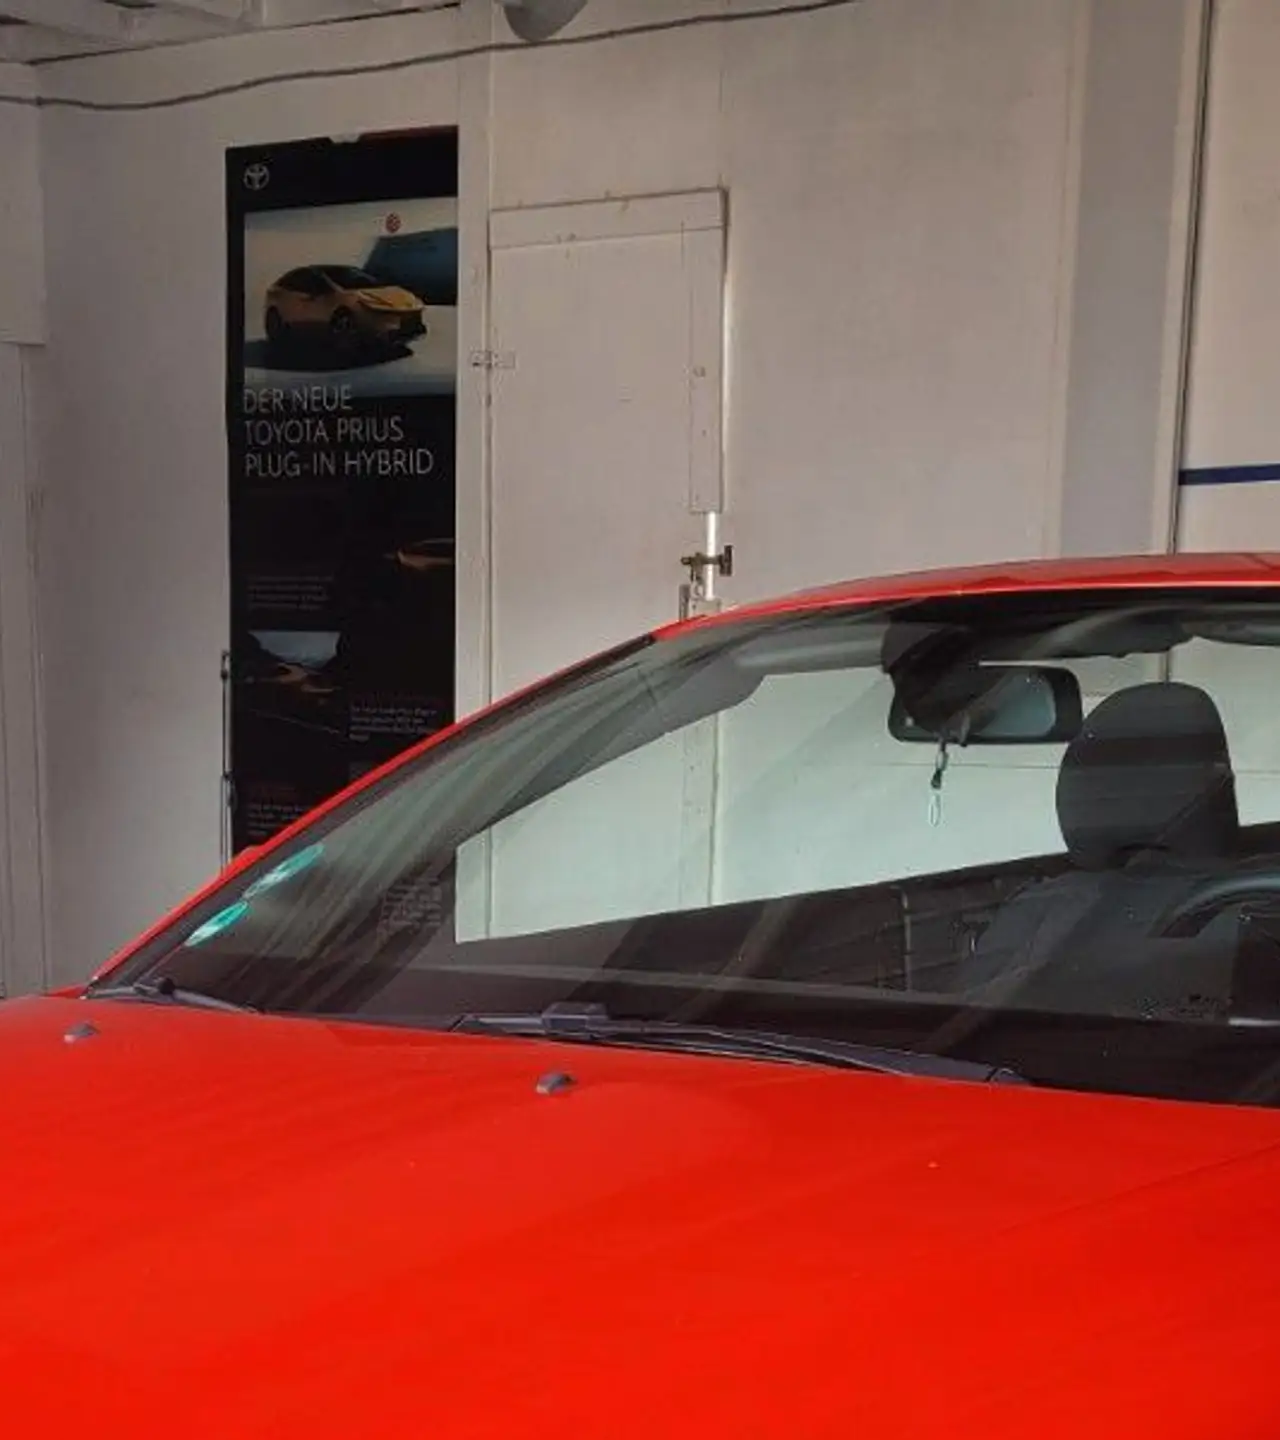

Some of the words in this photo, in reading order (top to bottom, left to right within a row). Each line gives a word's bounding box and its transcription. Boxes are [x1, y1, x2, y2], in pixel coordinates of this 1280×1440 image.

[244, 388, 284, 413] DER
[292, 385, 353, 411] NEUE
[245, 418, 329, 445] TOYOTA
[337, 416, 404, 443] PRIUS
[245, 452, 336, 478] PLUG-IN
[345, 448, 434, 475] HYBRID
